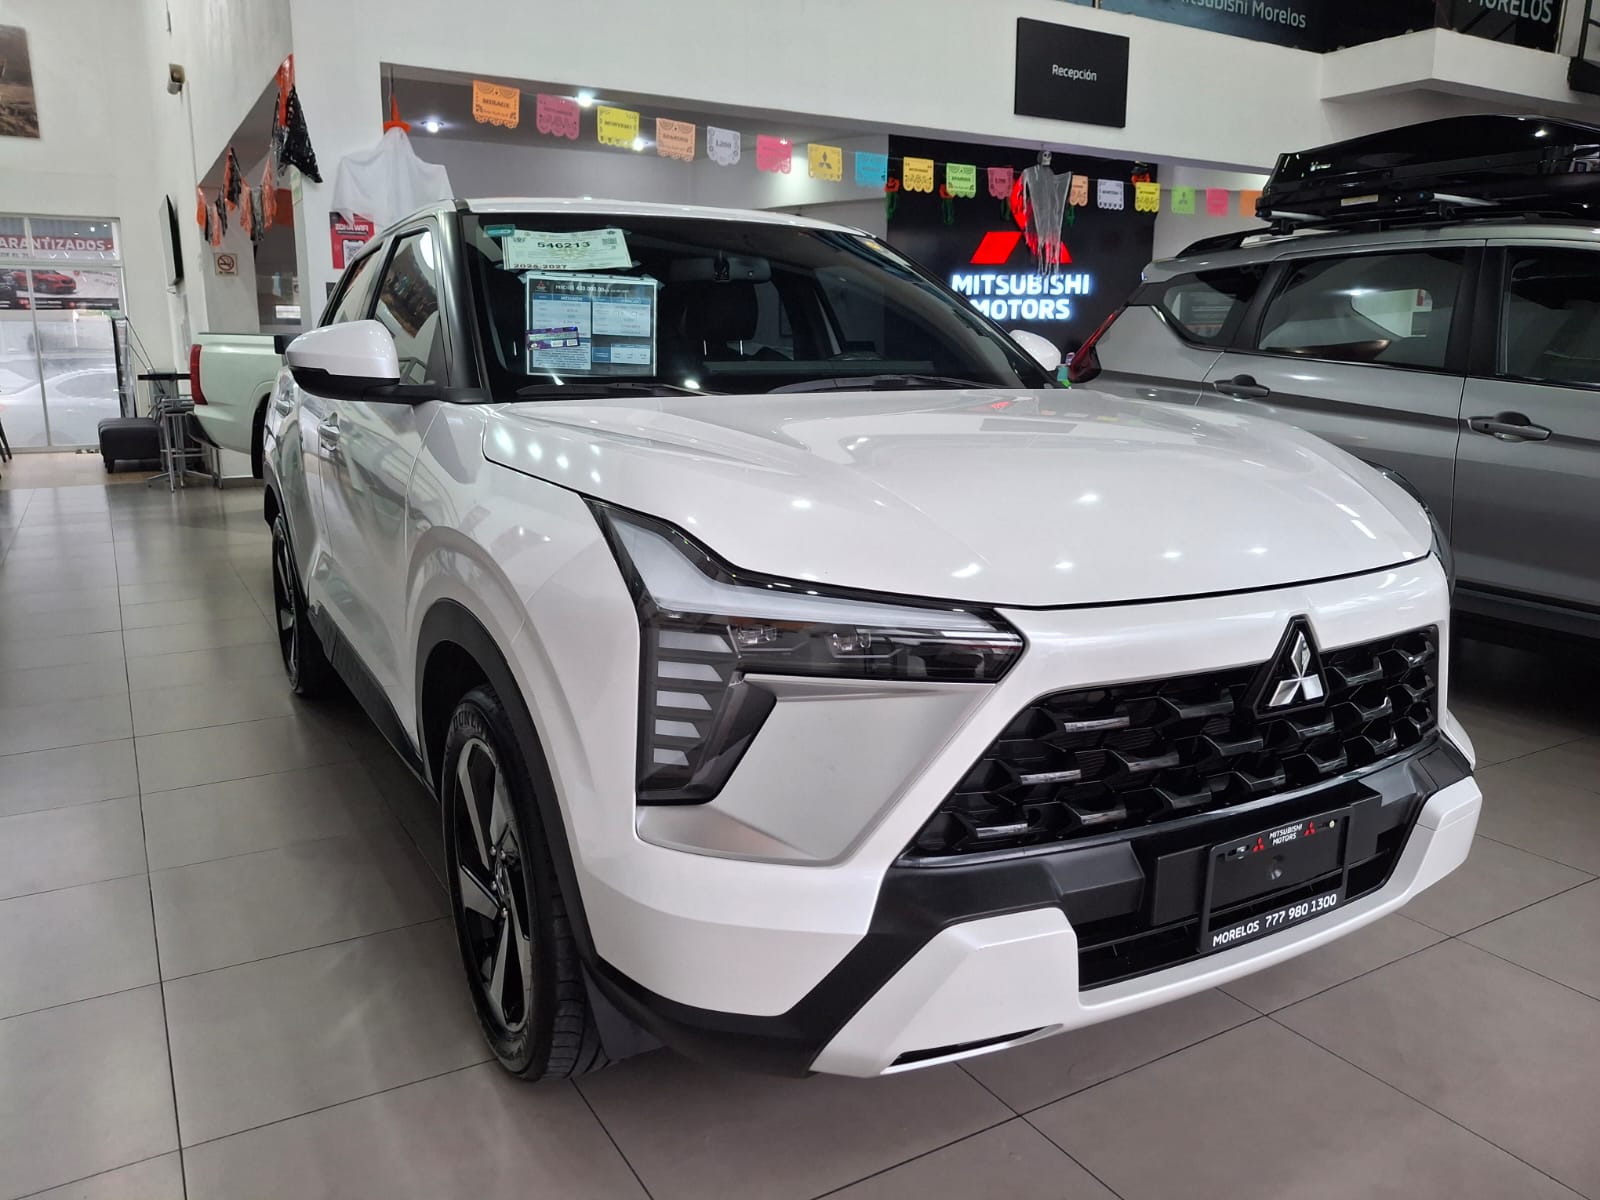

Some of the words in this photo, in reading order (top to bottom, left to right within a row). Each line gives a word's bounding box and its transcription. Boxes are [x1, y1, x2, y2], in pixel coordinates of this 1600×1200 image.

[1182, 0, 1247, 15] subishi
[1252, 2, 1306, 28] Morelos
[1468, 0, 1554, 24] RELOS
[1052, 63, 1097, 81] Recepción
[951, 273, 1090, 296] MITSUBISHI
[970, 298, 1071, 320] MOTORS
[1269, 824, 1303, 839] MITSUBISHI
[1272, 832, 1297, 846] MOTORS
[1212, 920, 1260, 947] MORELOS
[1265, 911, 1286, 928] 777
[1288, 904, 1309, 920] 980
[1310, 894, 1337, 913] 1300
